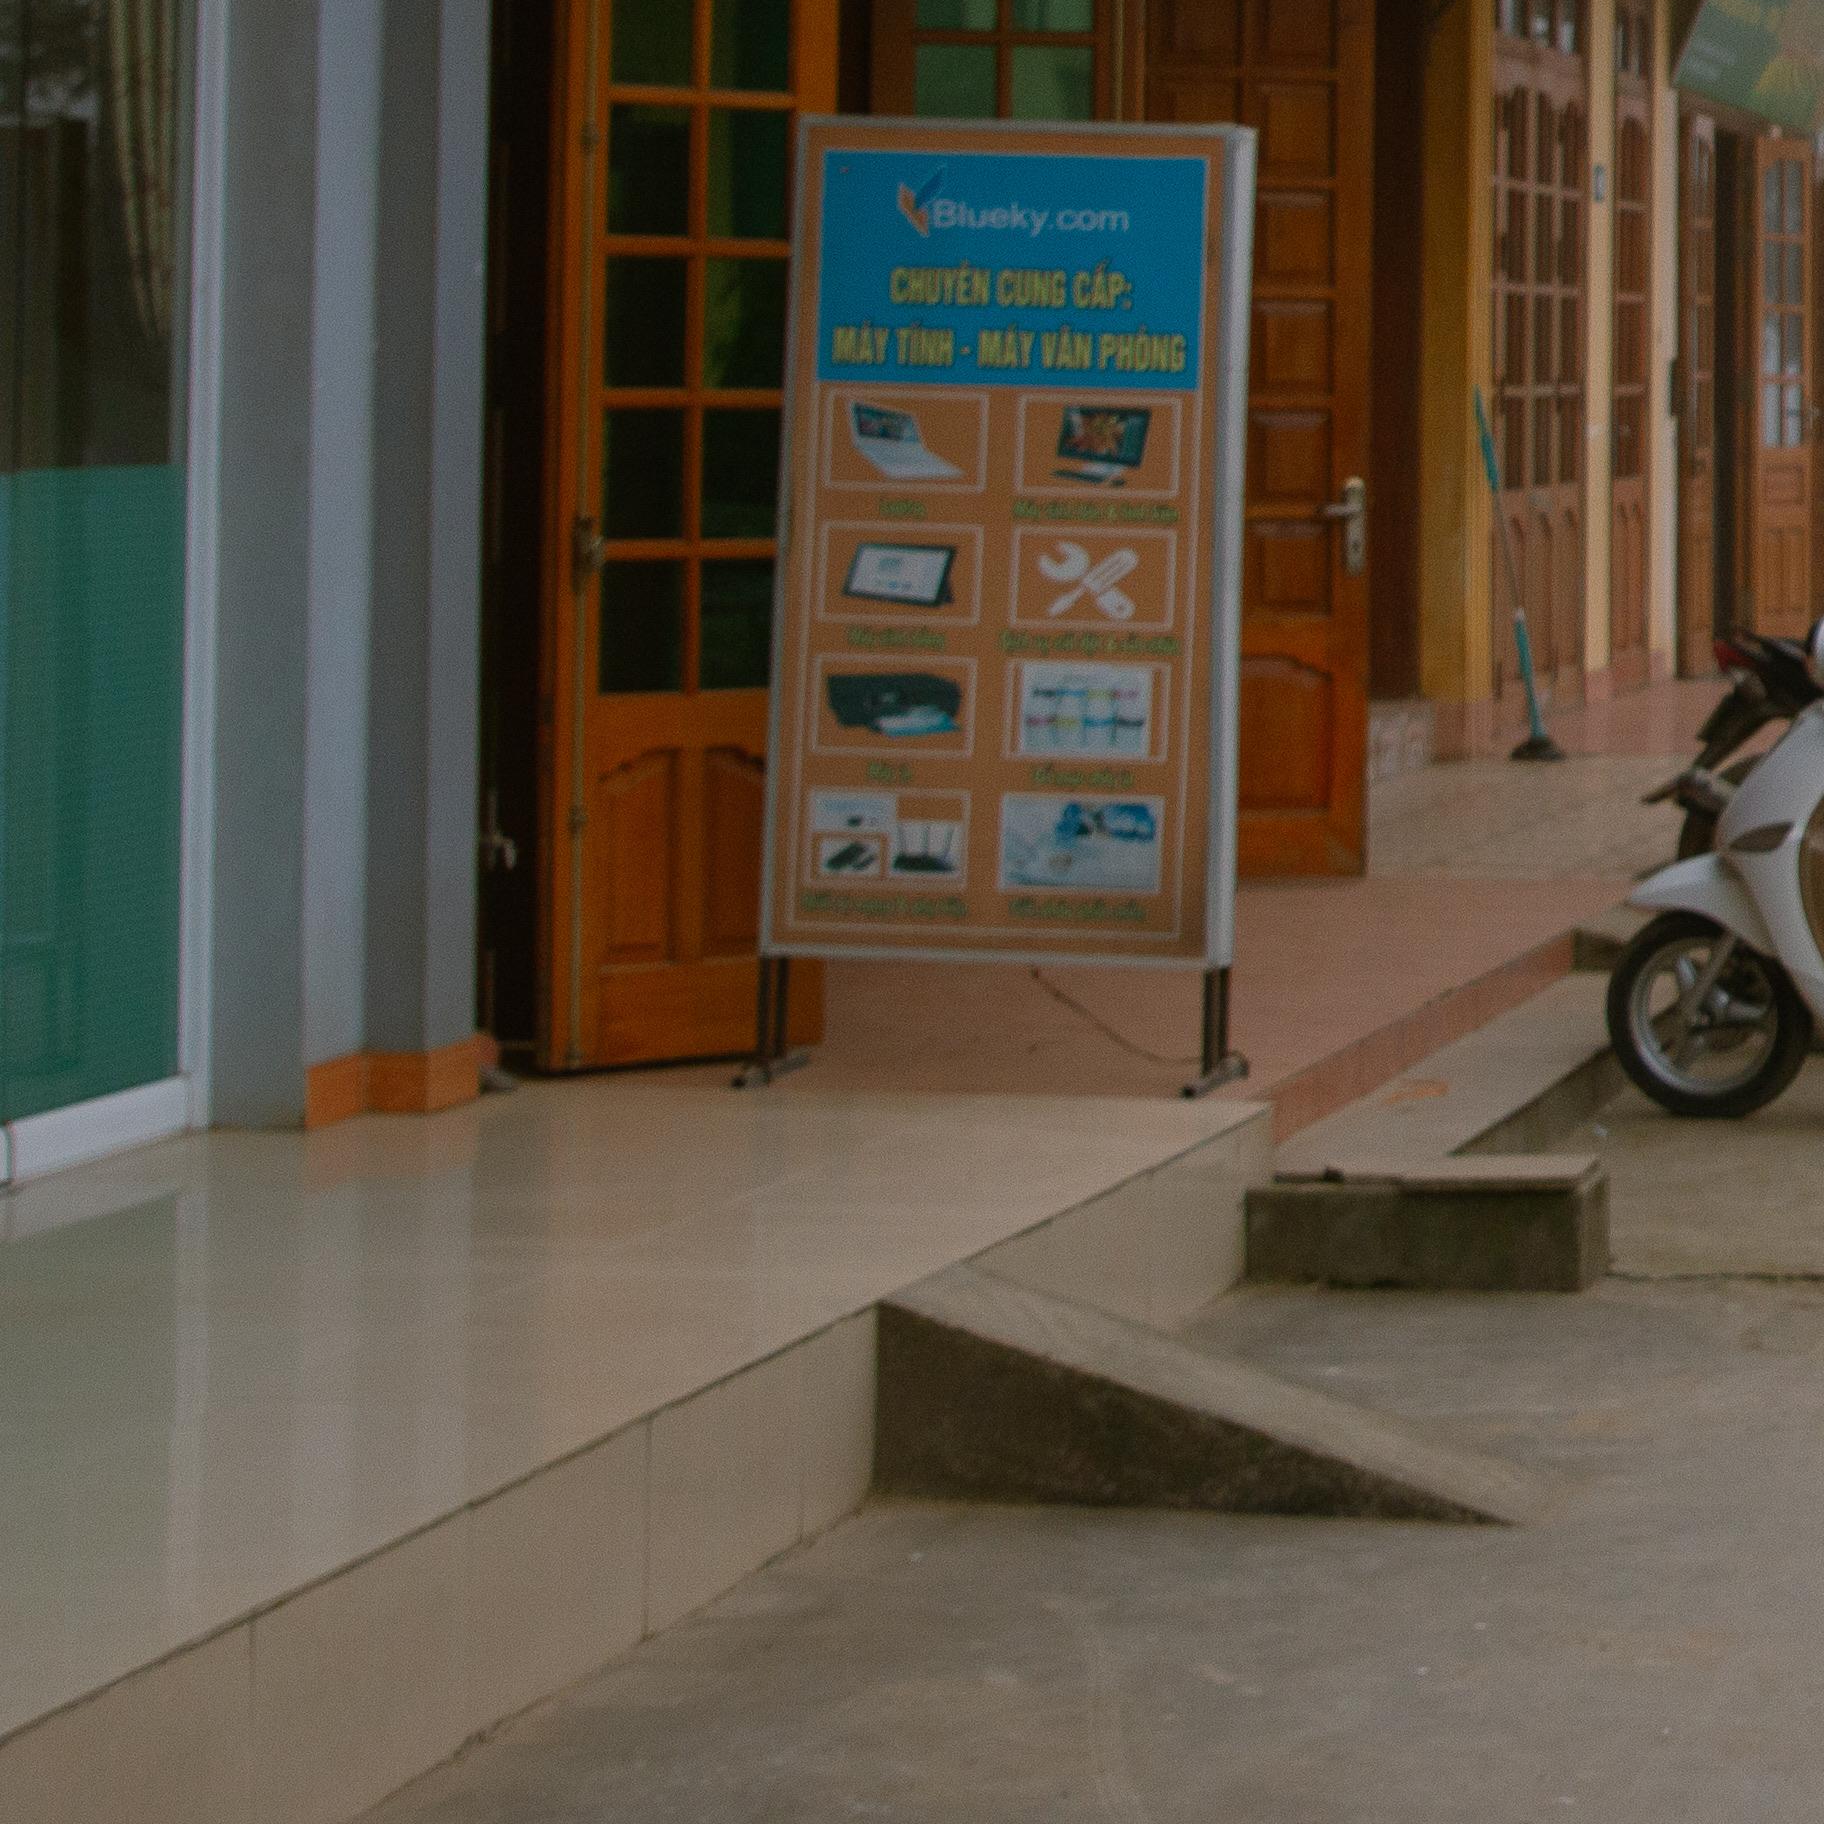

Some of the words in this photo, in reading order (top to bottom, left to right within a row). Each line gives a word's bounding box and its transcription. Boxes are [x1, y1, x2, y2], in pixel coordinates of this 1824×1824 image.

[932, 198, 1130, 237] Blueky.com
[996, 268, 1066, 308] CUNG
[831, 320, 889, 365] MÁY
[896, 321, 955, 367] TÍNH
[976, 323, 1034, 368] MÁY
